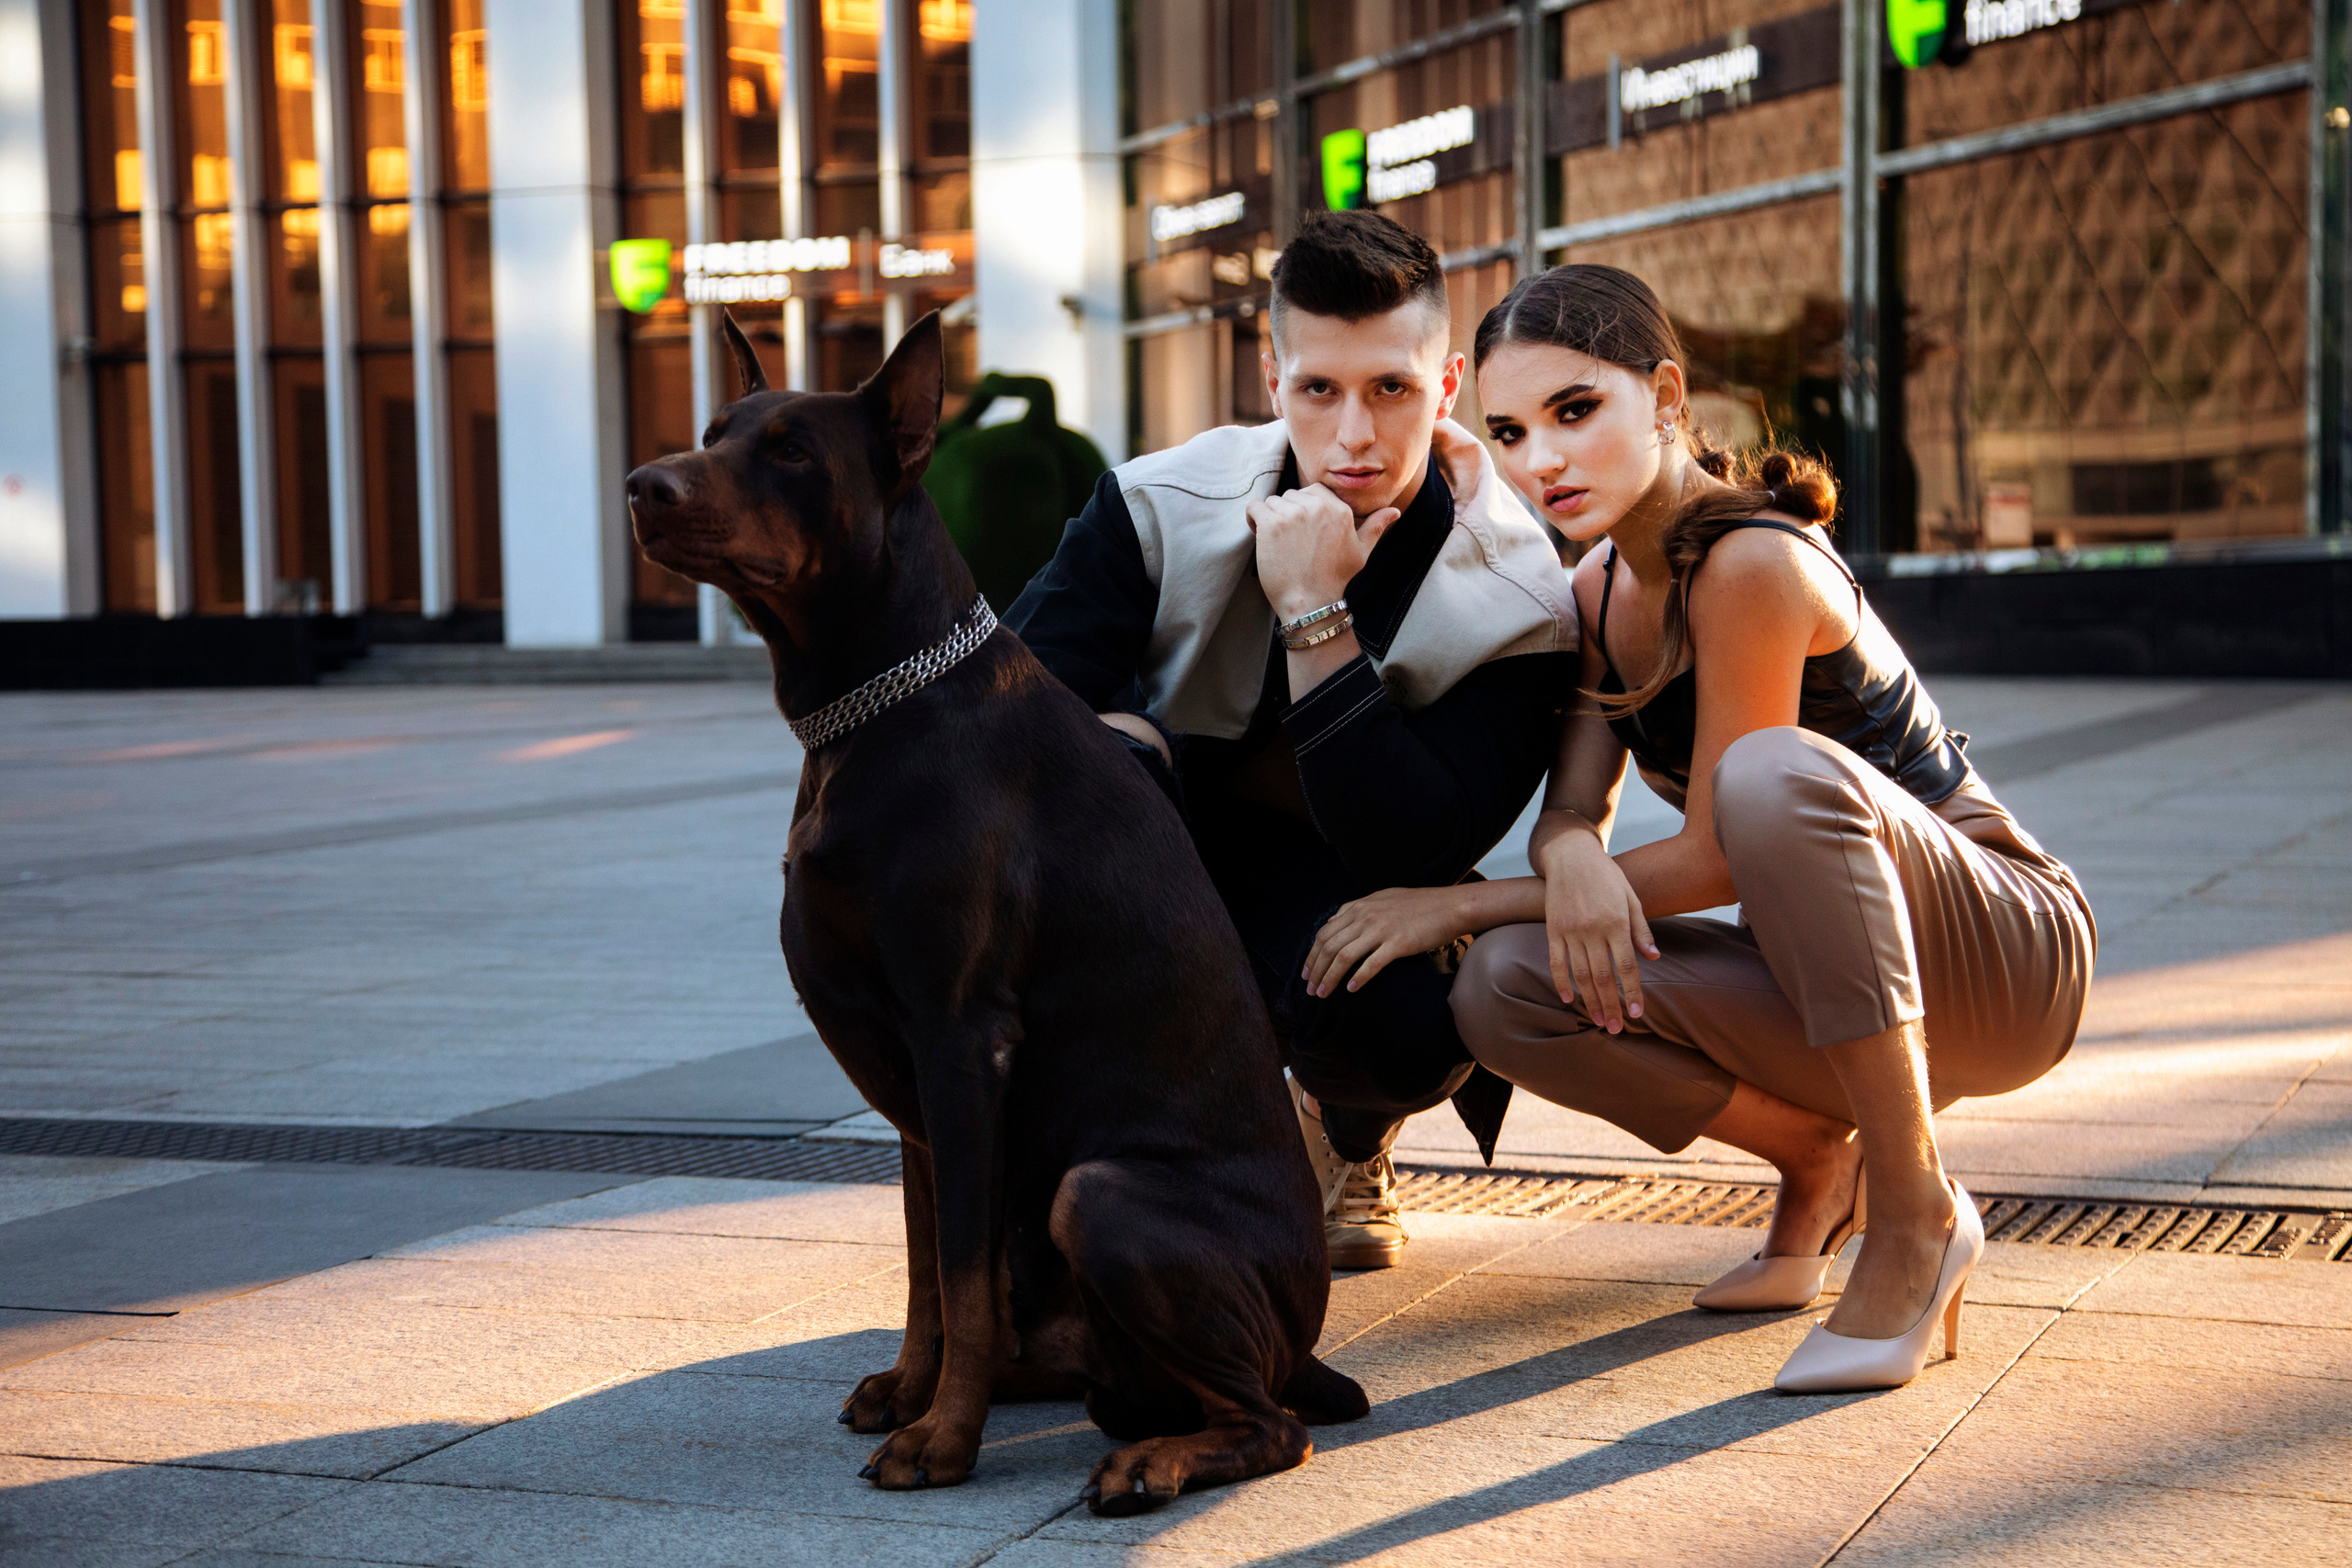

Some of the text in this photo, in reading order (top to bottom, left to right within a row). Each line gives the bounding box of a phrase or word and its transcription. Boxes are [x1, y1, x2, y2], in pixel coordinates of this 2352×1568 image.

[1964, 0, 2082, 46] finance
[1621, 44, 1759, 113] Инвестиции
[684, 235, 851, 275] FREEDOM
[684, 271, 792, 304] finance
